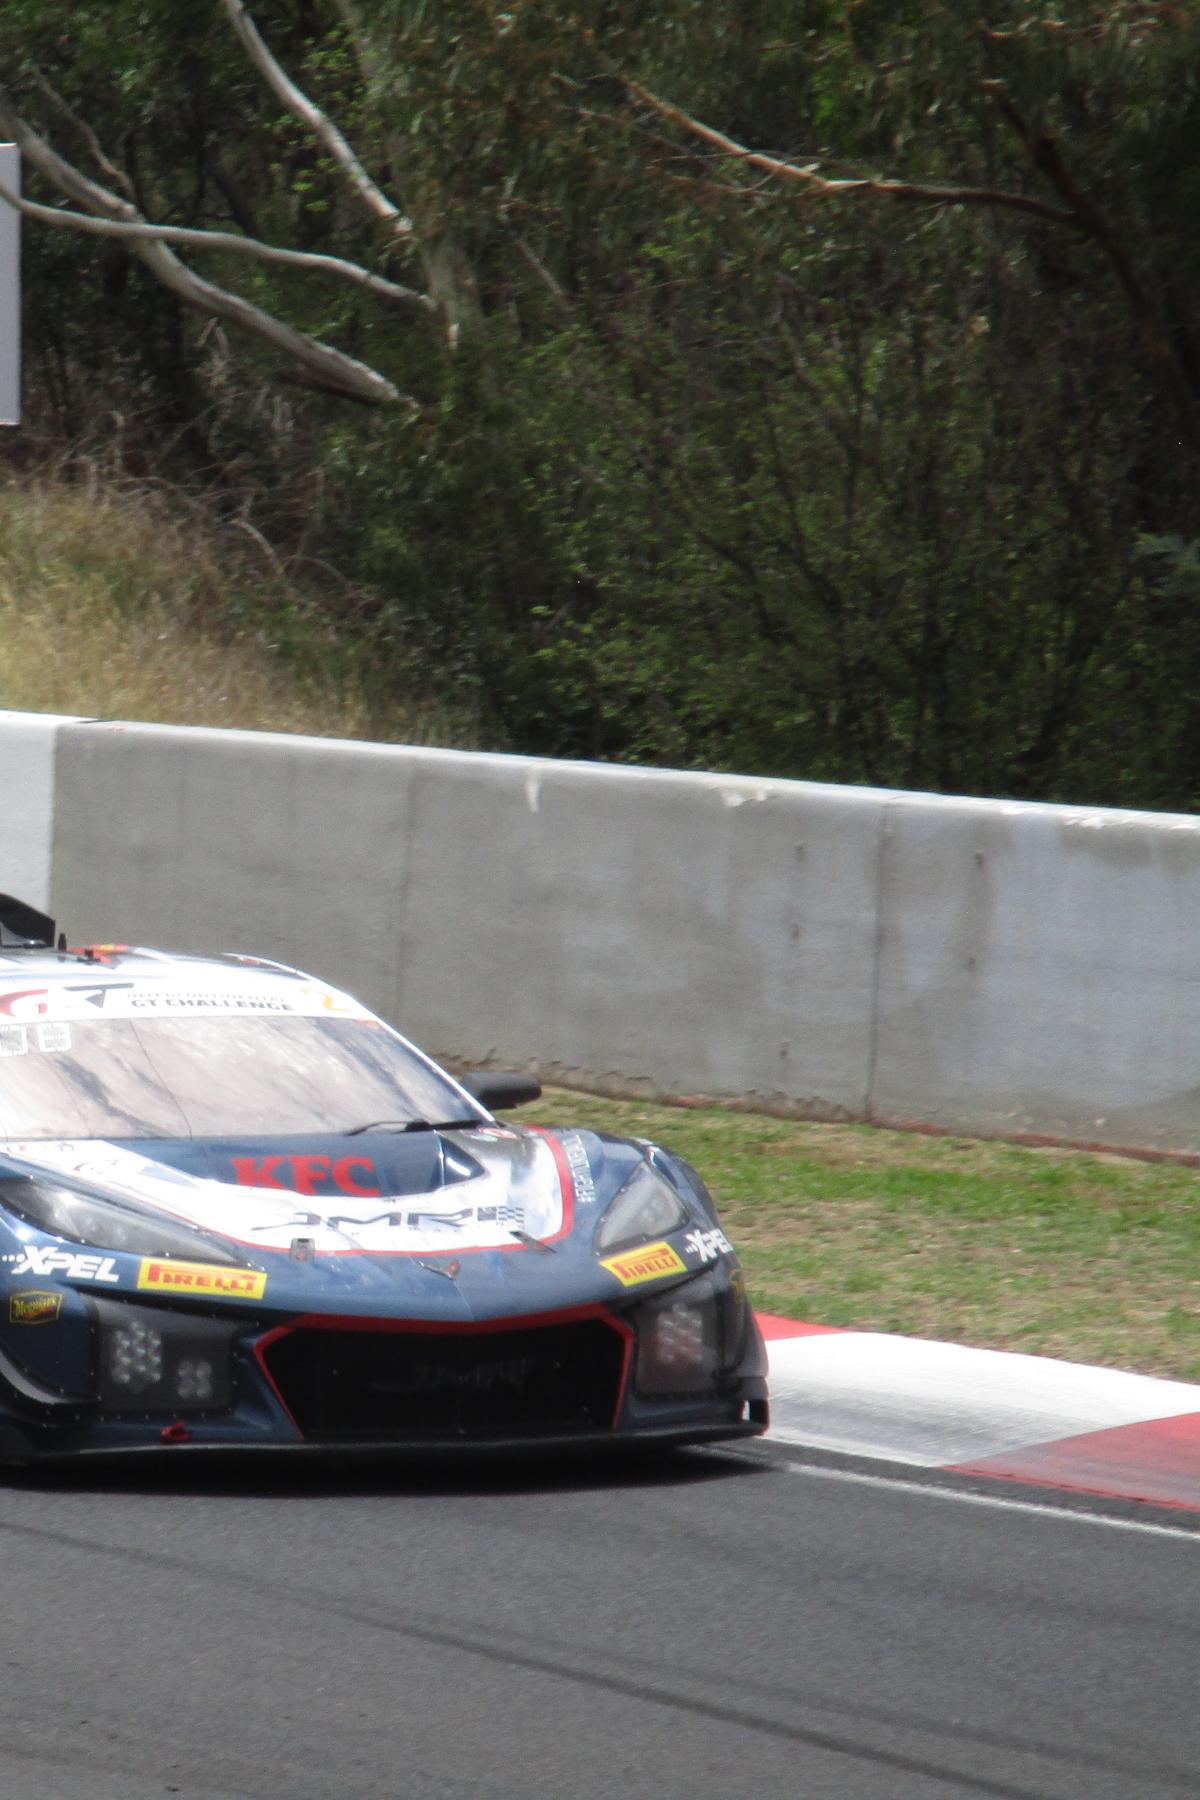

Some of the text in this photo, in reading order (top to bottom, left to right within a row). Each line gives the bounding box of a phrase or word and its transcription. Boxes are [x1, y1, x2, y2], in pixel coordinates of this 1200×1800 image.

[165, 999, 294, 1011] CHALLENGE
[230, 1154, 382, 1198] KFC
[10, 1246, 119, 1284] XPEL
[147, 1263, 257, 1292] PIRELLI
[613, 1248, 678, 1279] PIRELLI
